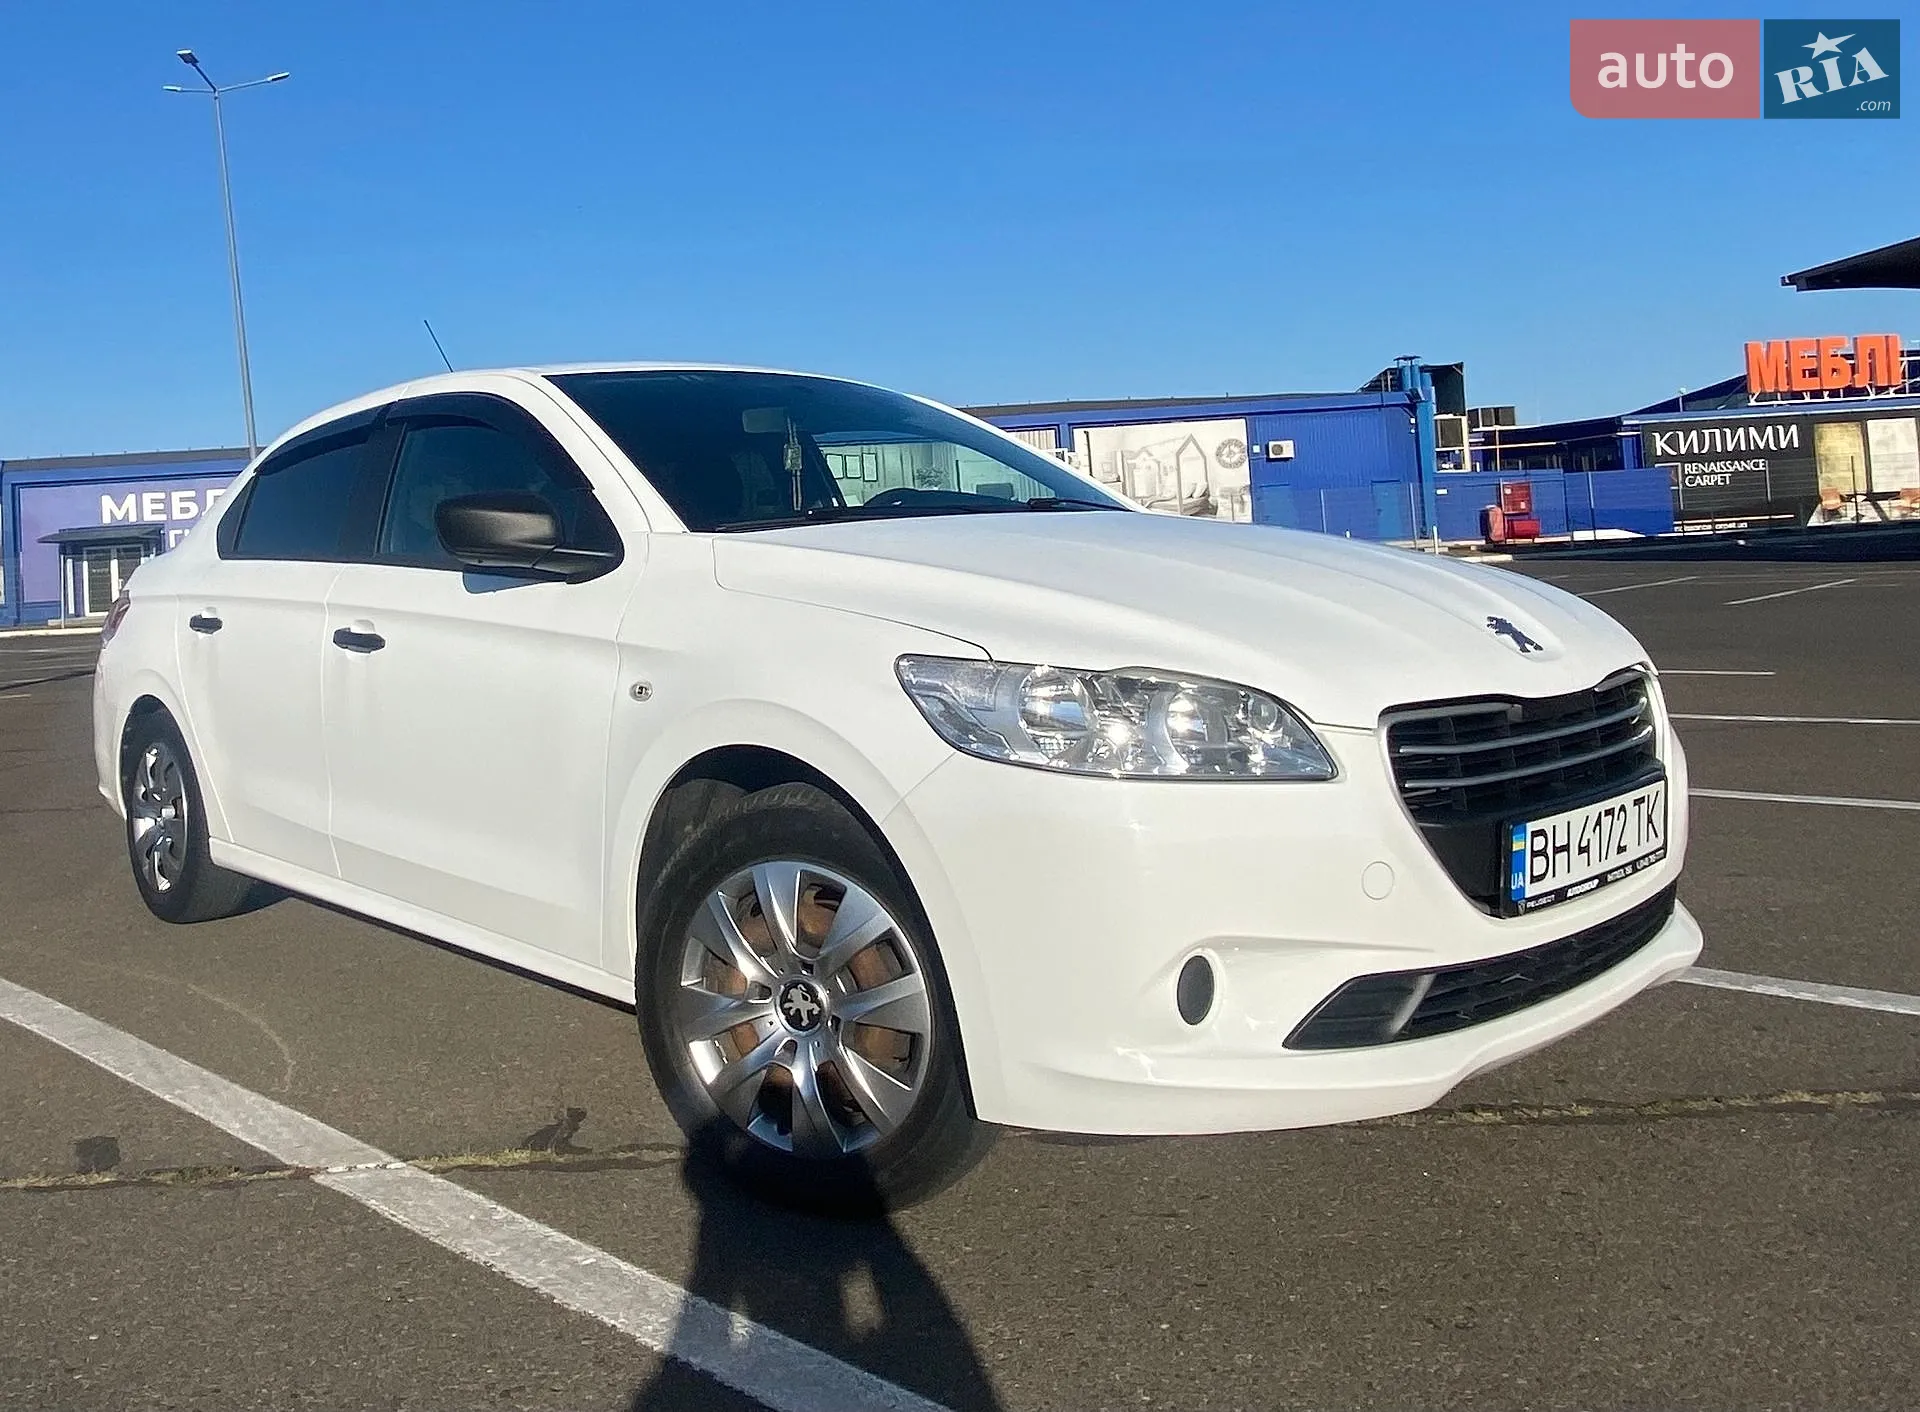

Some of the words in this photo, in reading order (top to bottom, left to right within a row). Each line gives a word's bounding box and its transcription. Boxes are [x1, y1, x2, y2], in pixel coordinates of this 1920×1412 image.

[1744, 333, 1902, 394] МЕБЛІ
[1651, 423, 1800, 457] КИЛИМИ
[1683, 458, 1767, 475] RENAISSANCE
[1684, 473, 1732, 488] CARPET
[1529, 820, 1571, 884] BH
[1577, 803, 1628, 868] 4172
[1633, 790, 1660, 848] TK
[1511, 871, 1525, 890] UA
